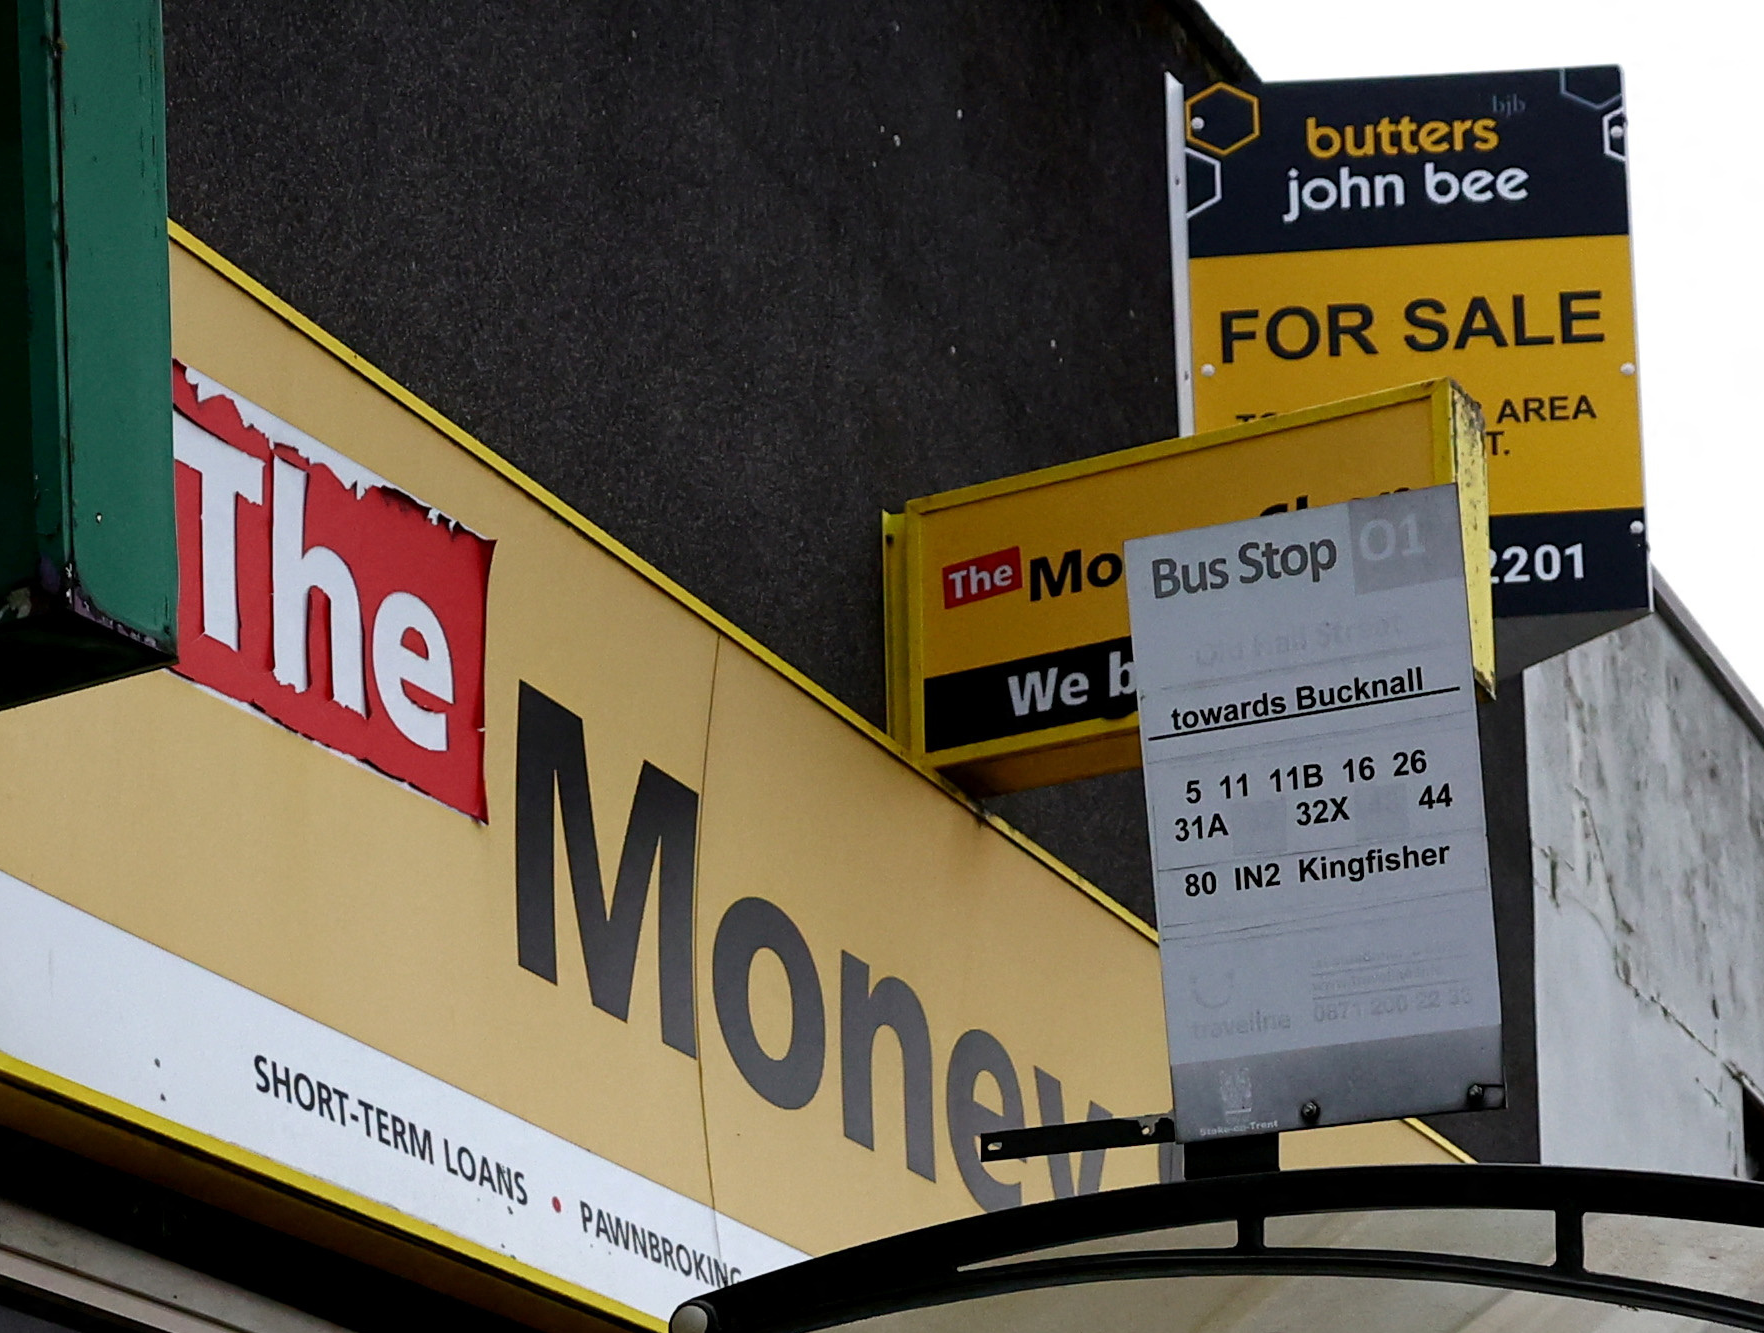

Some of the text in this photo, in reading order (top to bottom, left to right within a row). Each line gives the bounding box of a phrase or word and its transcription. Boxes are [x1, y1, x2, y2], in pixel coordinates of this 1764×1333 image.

[1305, 116, 1500, 159] butters
[1282, 162, 1529, 223] john bee
[1220, 290, 1606, 364] FOR SALE
[1497, 395, 1597, 423] AREA
[174, 409, 456, 753] The
[948, 549, 1123, 602] The Mo
[1152, 555, 1229, 599] Bus
[1238, 538, 1337, 585] Stop
[1007, 667, 1089, 717] We
[1171, 666, 1424, 731] towards Bucknall
[1185, 749, 1428, 804] 5 11 11B 16 26
[1174, 783, 1454, 842] 31A 32X 44
[1185, 843, 1451, 898] 80 IN2 Kingfisher
[253, 1054, 435, 1164] SHORT-TERM
[443, 1138, 529, 1206] LOANS
